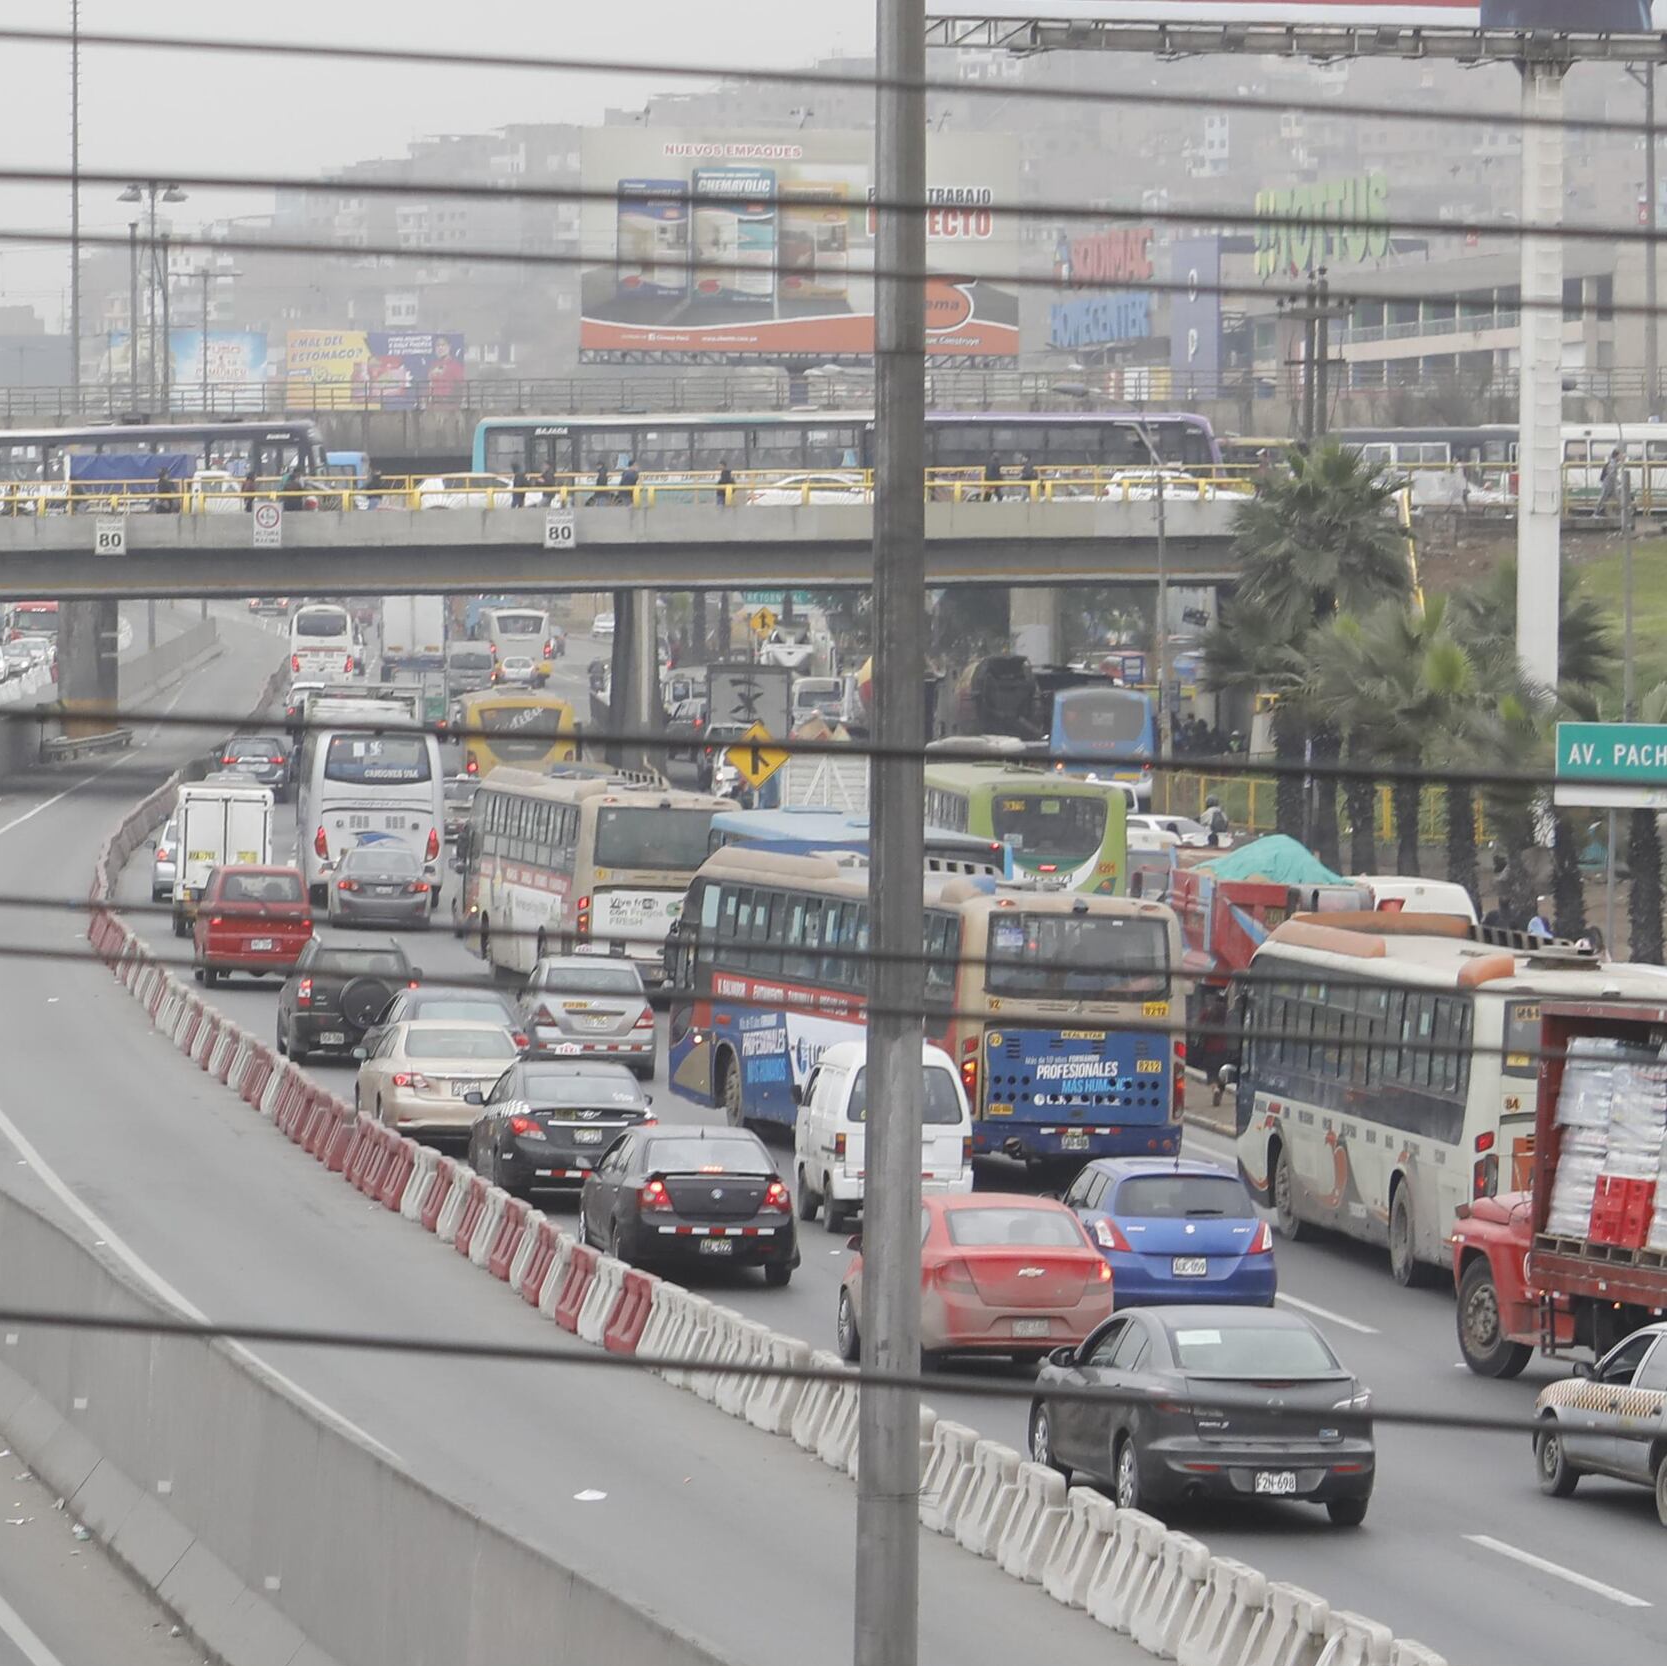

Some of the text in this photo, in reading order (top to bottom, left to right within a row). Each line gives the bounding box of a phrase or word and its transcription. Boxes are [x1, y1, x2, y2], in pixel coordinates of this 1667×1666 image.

[664, 143, 802, 159] NUEVOS EMPAQUES
[99, 533, 122, 547] 80
[548, 526, 572, 540] 80
[1568, 743, 1602, 765] AV.
[1036, 1061, 1119, 1080] PROFESIONALES
